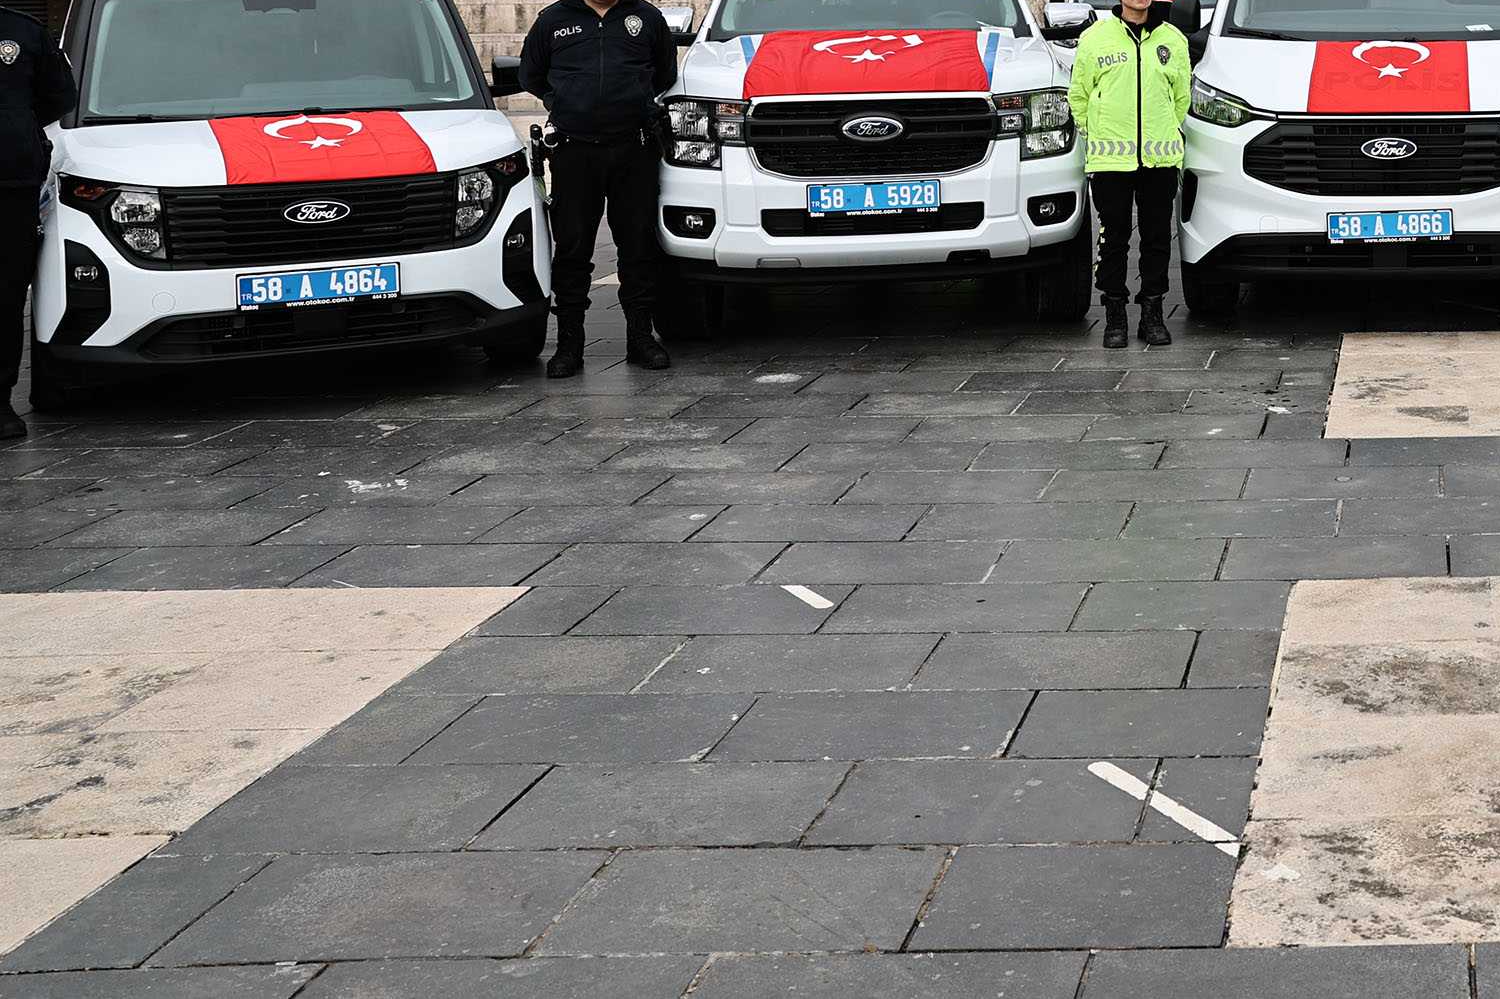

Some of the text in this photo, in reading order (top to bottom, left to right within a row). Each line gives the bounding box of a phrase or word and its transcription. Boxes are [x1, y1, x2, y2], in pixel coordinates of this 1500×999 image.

[857, 121, 889, 136] Ford
[1370, 140, 1407, 156] Ford
[820, 188, 844, 209] 58
[863, 187, 875, 208] A
[887, 184, 935, 206] 5928
[296, 204, 338, 220] Ford
[1338, 216, 1362, 237] 58
[1374, 215, 1385, 236] A
[1397, 213, 1443, 235] 4866
[241, 268, 387, 302] TR 58 A 4864
[286, 296, 355, 308] www.otokoc.com.tr
